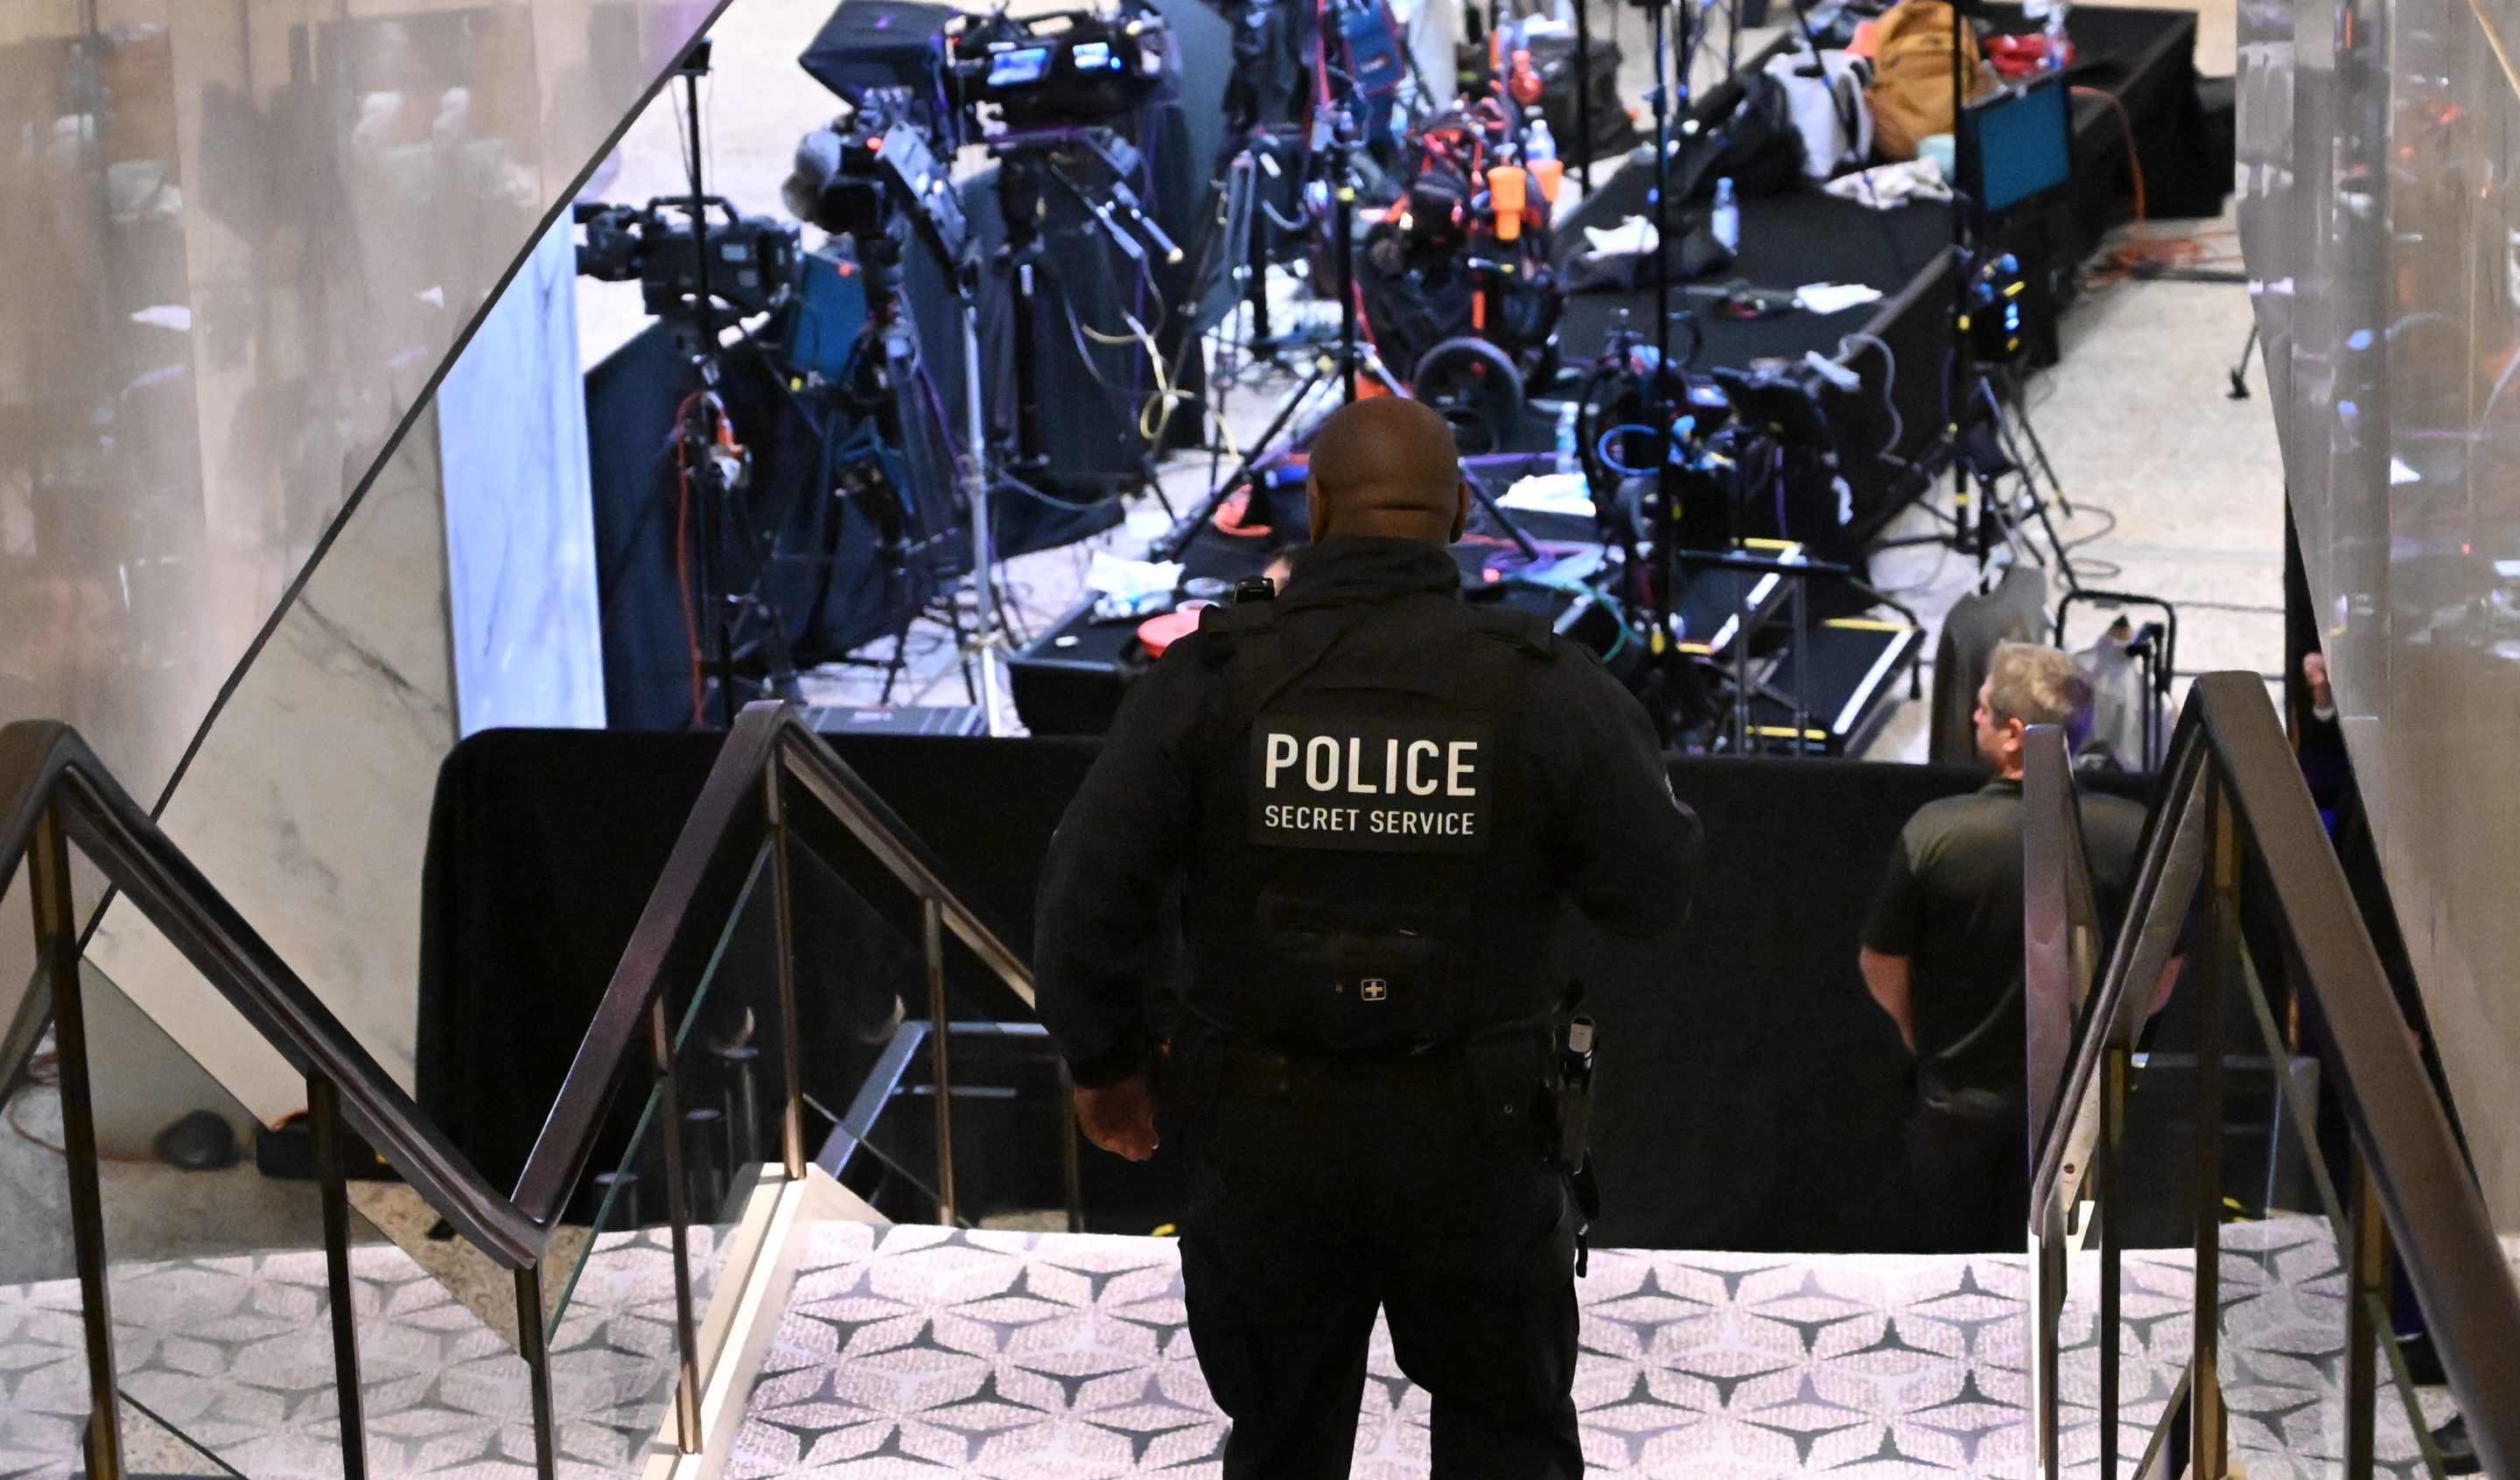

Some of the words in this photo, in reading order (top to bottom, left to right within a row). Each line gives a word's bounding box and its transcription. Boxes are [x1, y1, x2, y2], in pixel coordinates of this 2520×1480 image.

[1265, 733, 1477, 796] POLICE
[1264, 804, 1360, 831] SECRET
[1369, 810, 1475, 835] SERVICE
